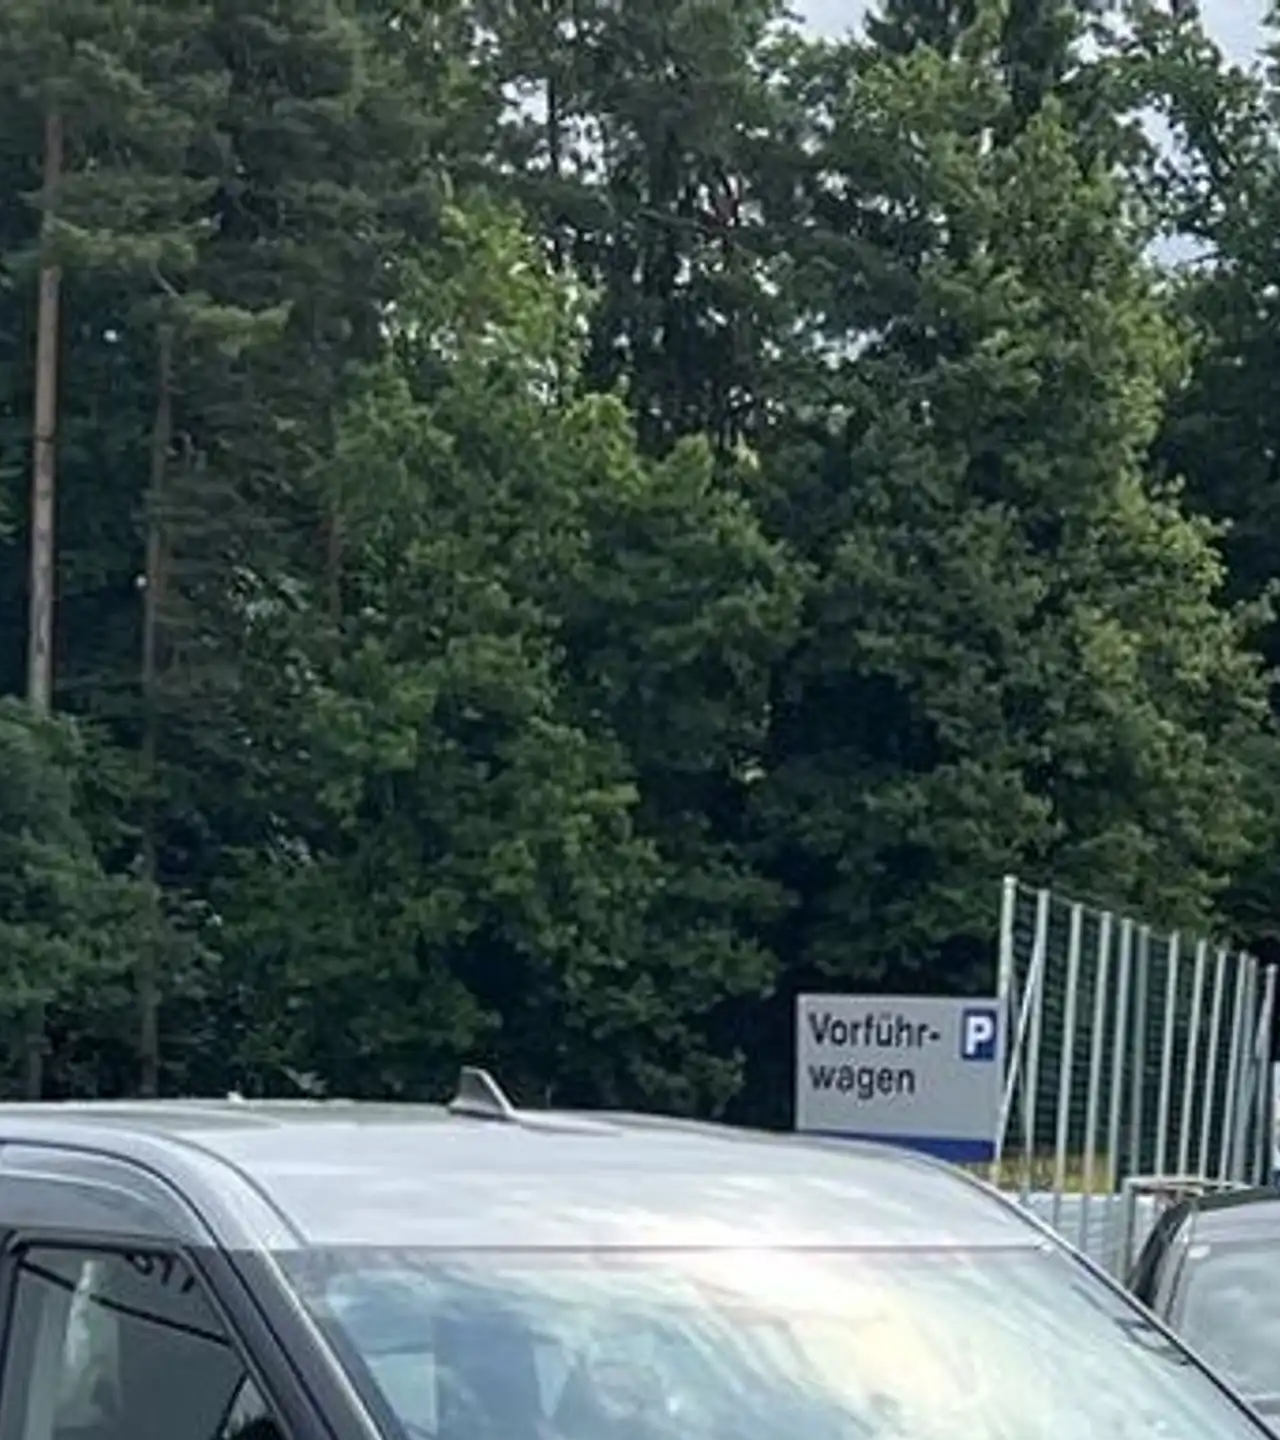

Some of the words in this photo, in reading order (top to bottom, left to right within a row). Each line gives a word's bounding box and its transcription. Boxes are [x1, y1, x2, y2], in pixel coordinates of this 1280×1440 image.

[808, 1012, 941, 1047] Vorführ-
[966, 1015, 994, 1055] P
[808, 1063, 916, 1100] wagen
